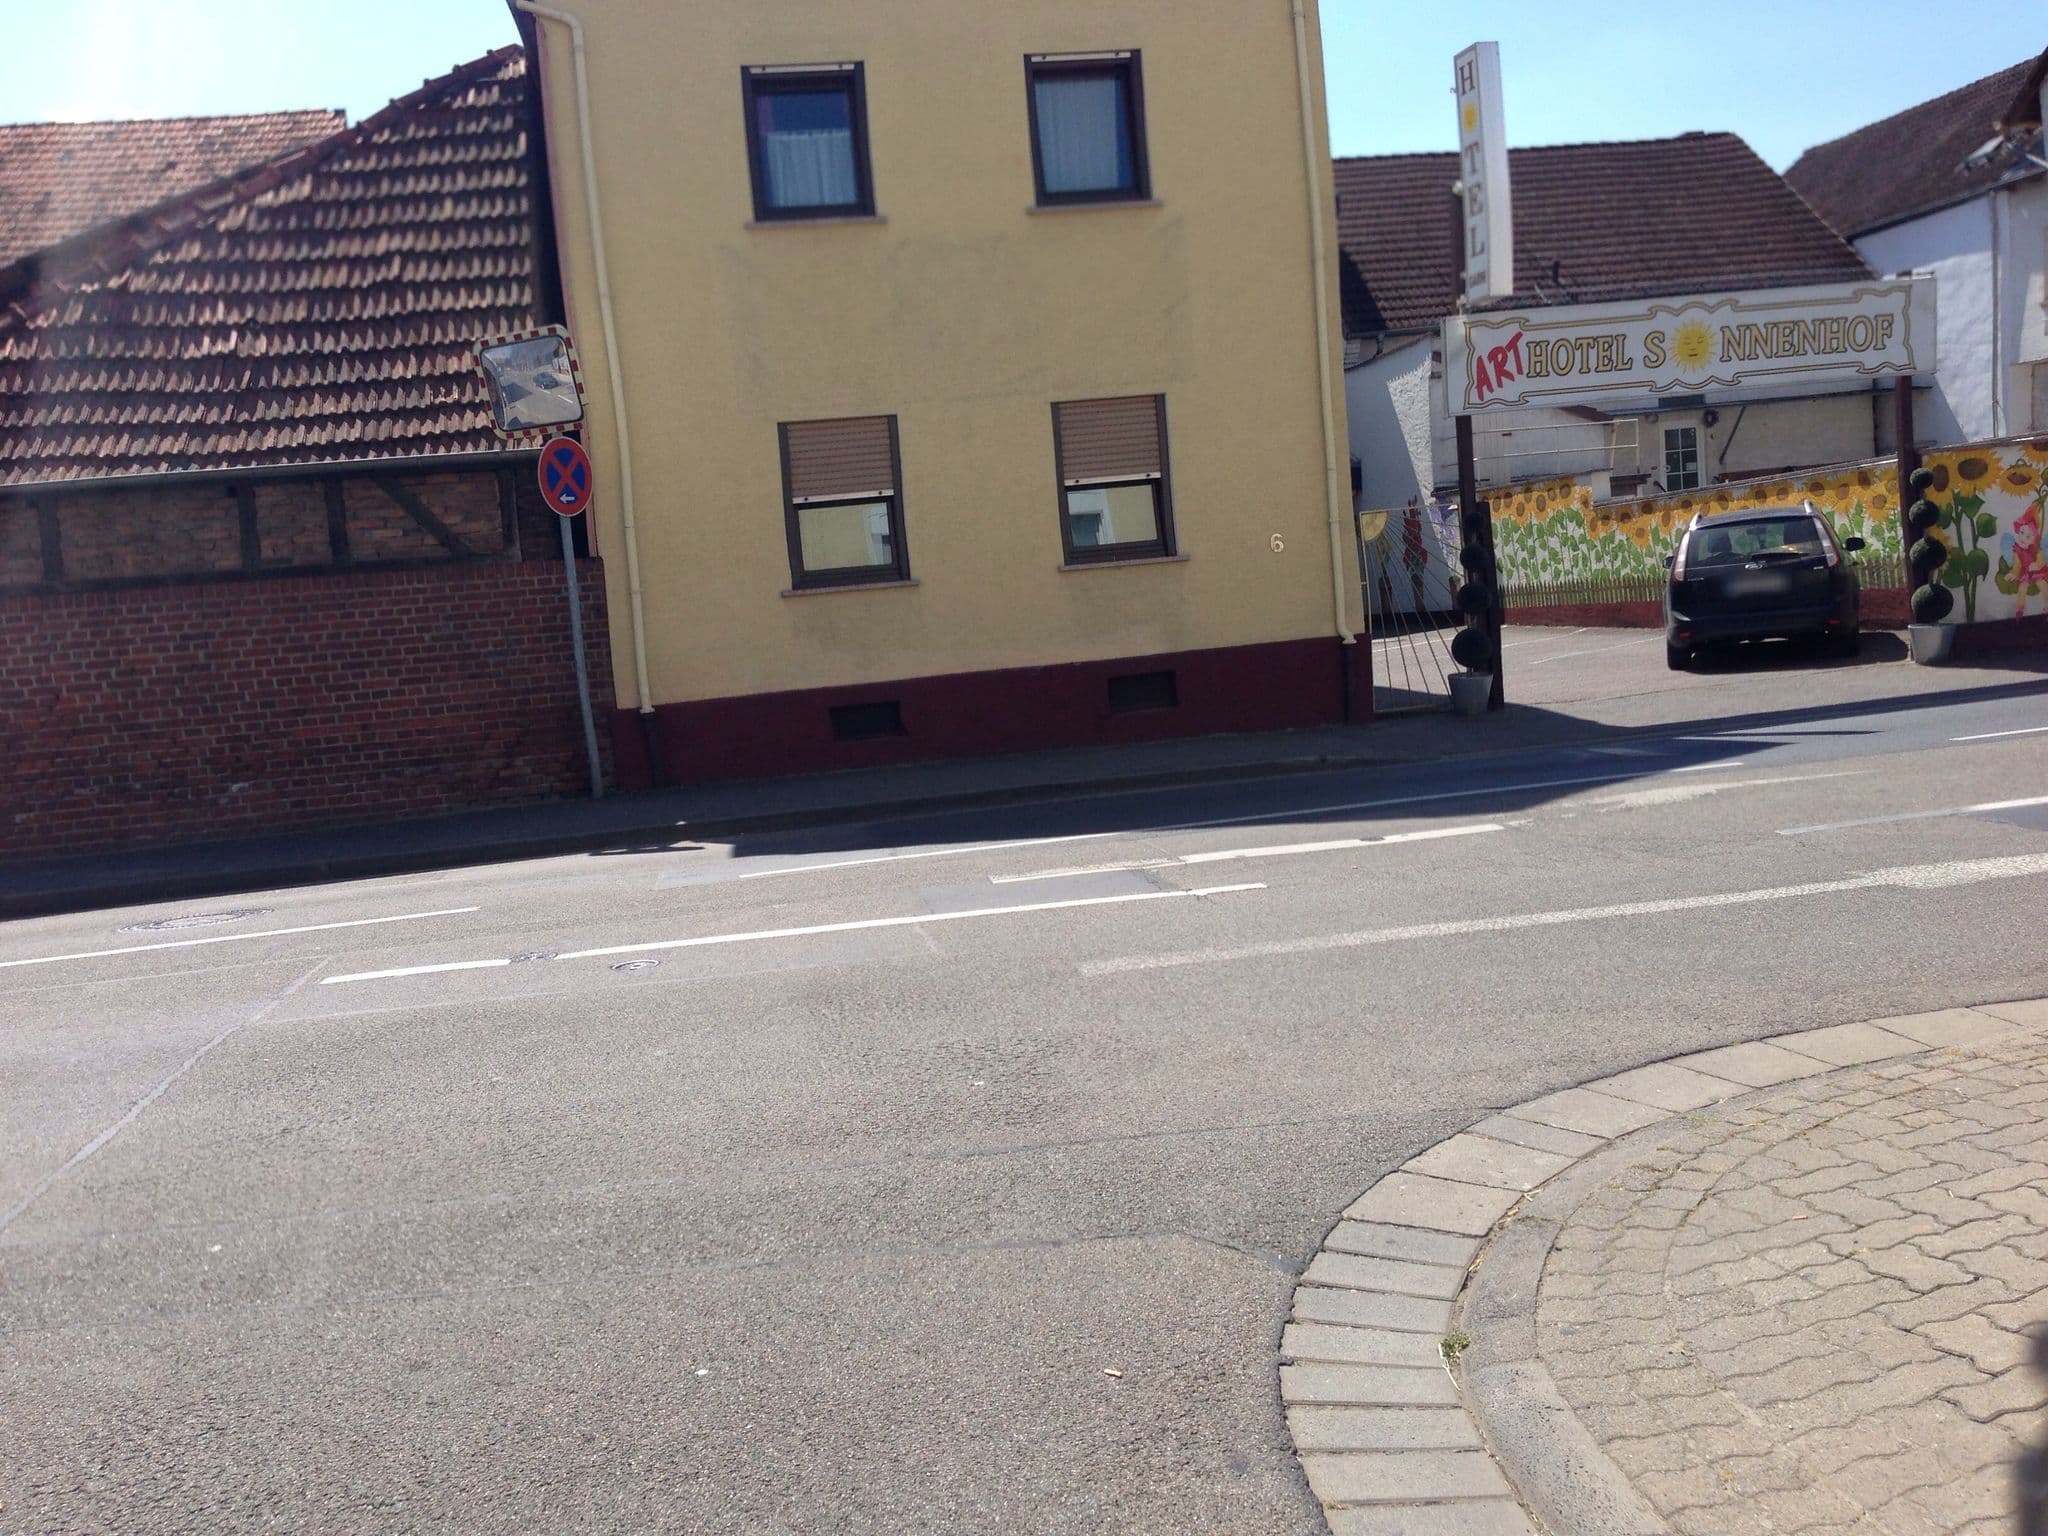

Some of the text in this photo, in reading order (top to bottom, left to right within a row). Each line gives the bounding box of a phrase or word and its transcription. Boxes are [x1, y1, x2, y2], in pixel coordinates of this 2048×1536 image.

[1476, 331, 1524, 401] ART
[1526, 334, 1633, 378] HOTEL
[1270, 533, 1284, 552] 6
